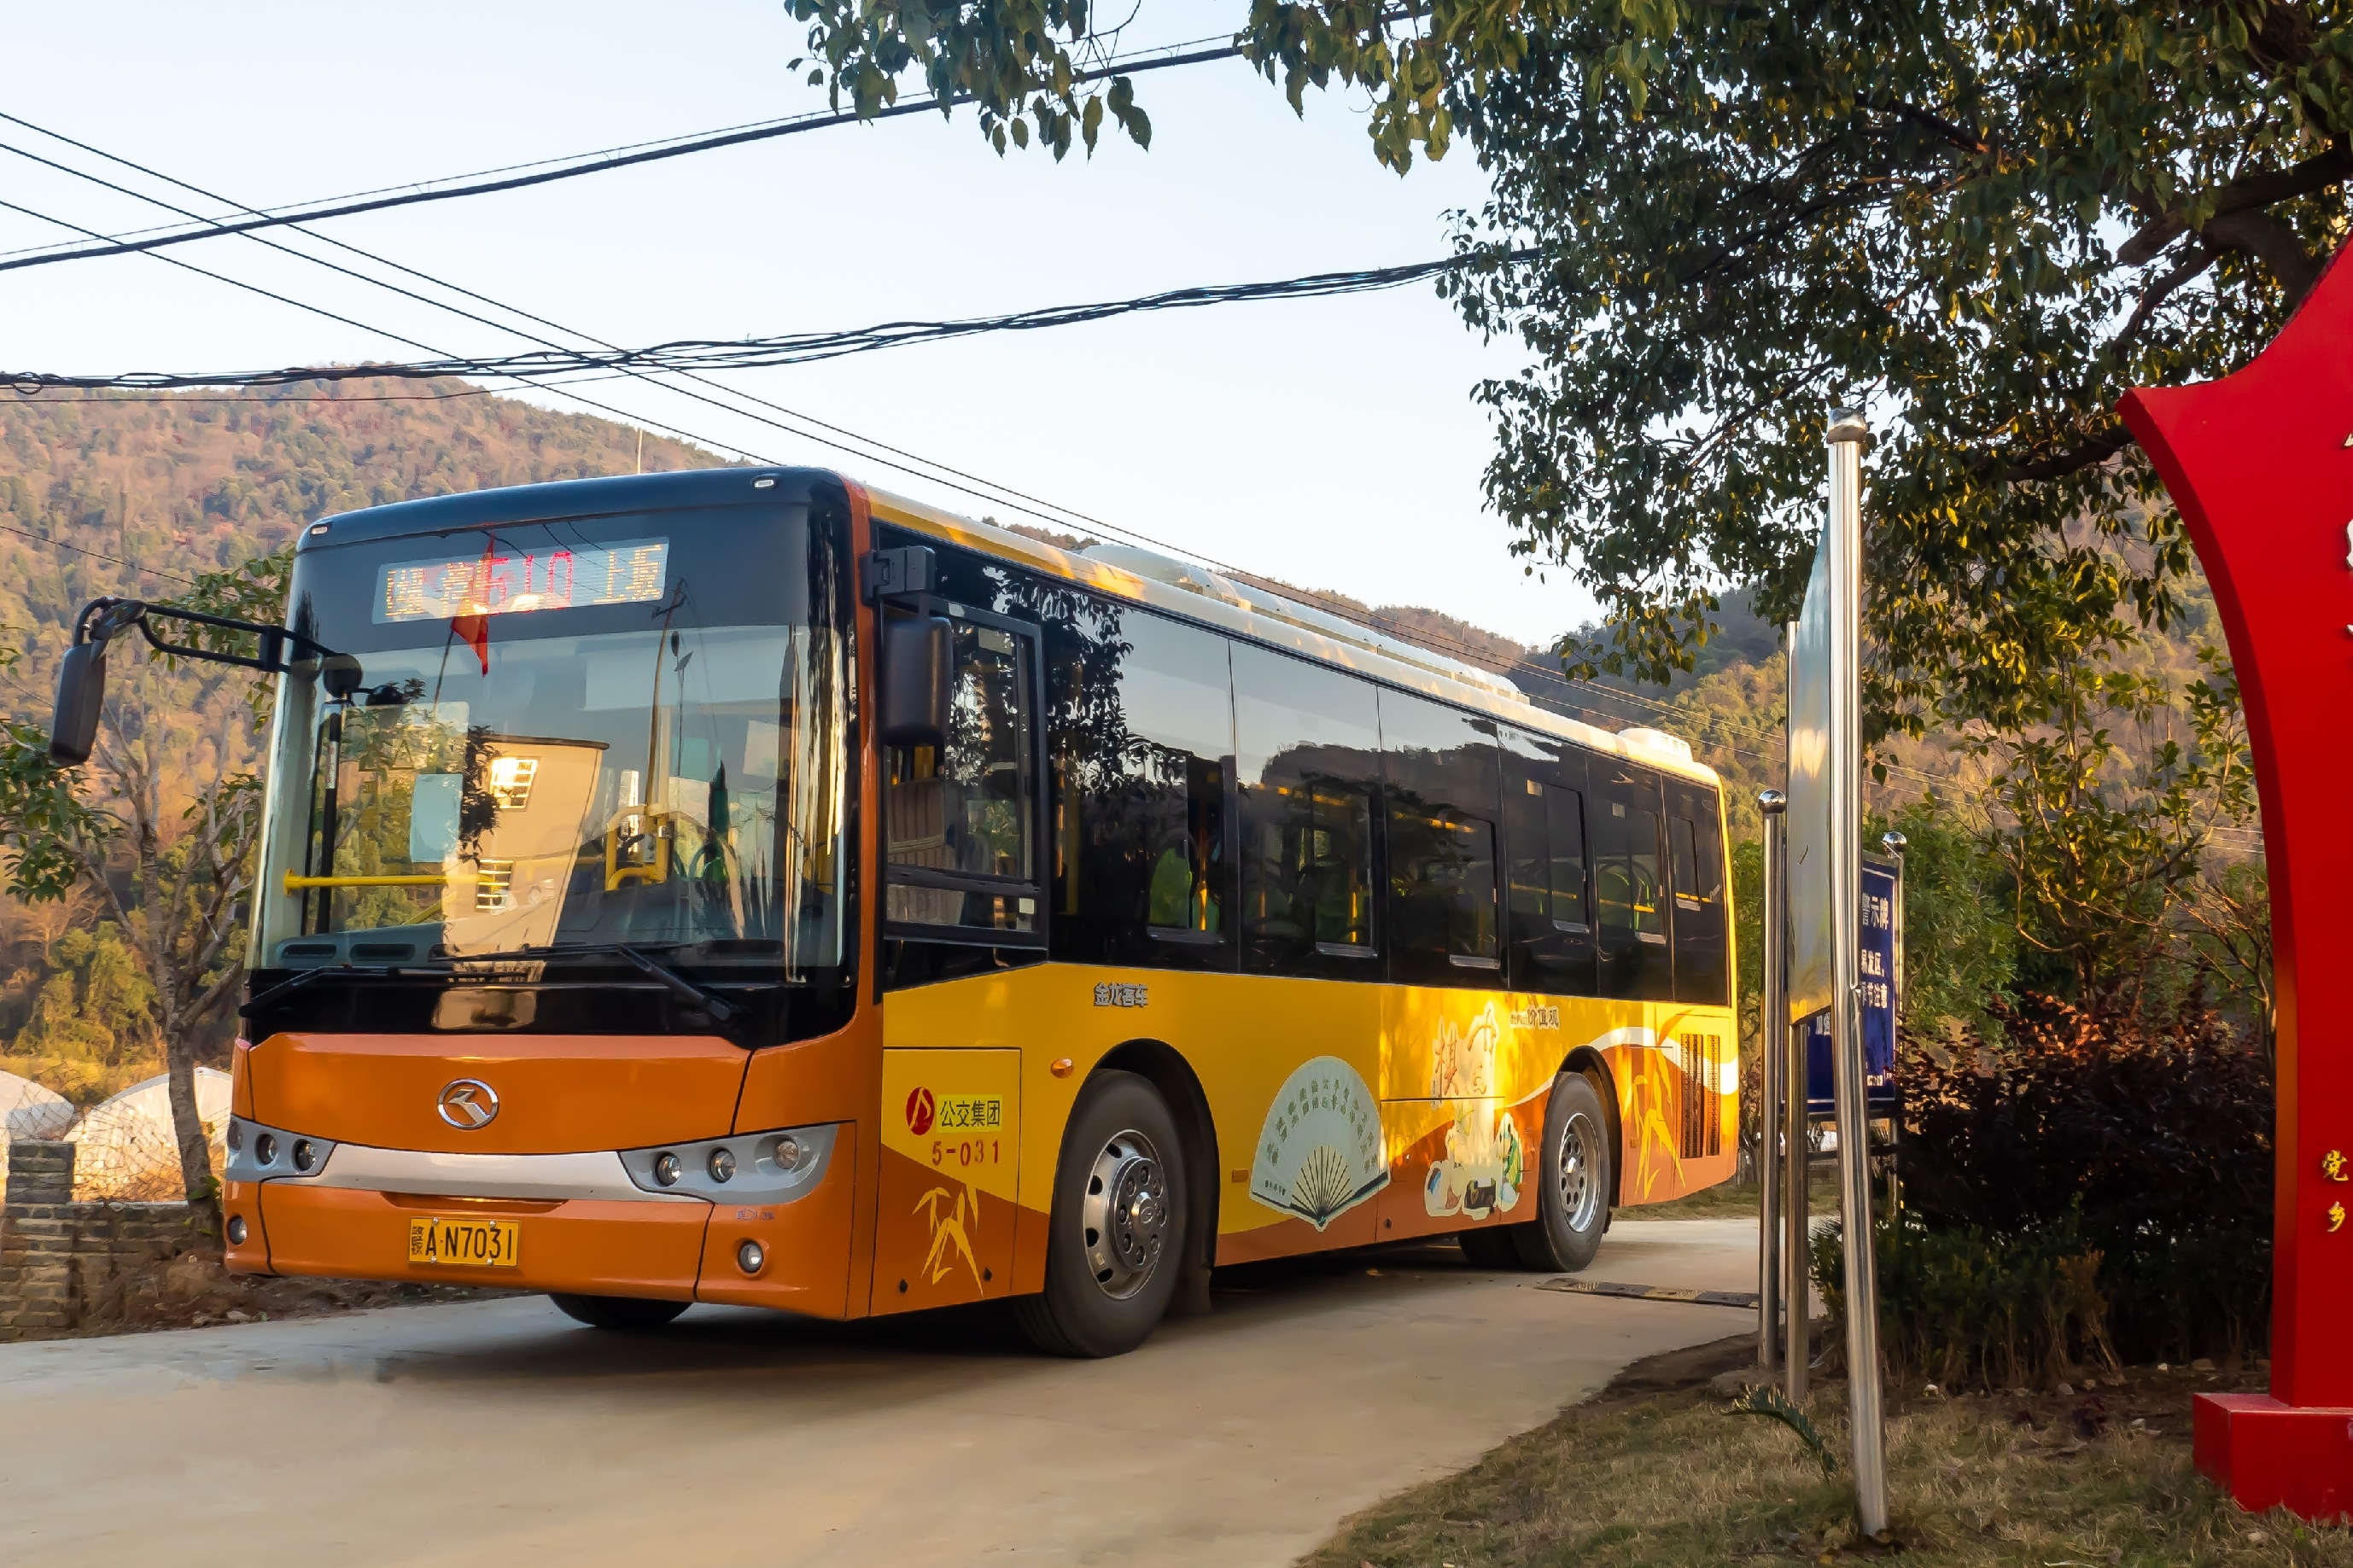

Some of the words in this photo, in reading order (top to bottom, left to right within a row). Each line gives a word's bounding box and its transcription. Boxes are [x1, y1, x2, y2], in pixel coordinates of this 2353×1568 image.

[1094, 982, 1148, 1008] 金龙客车
[940, 1100, 1000, 1127] 公交集团
[931, 1139, 1000, 1167] 5-031
